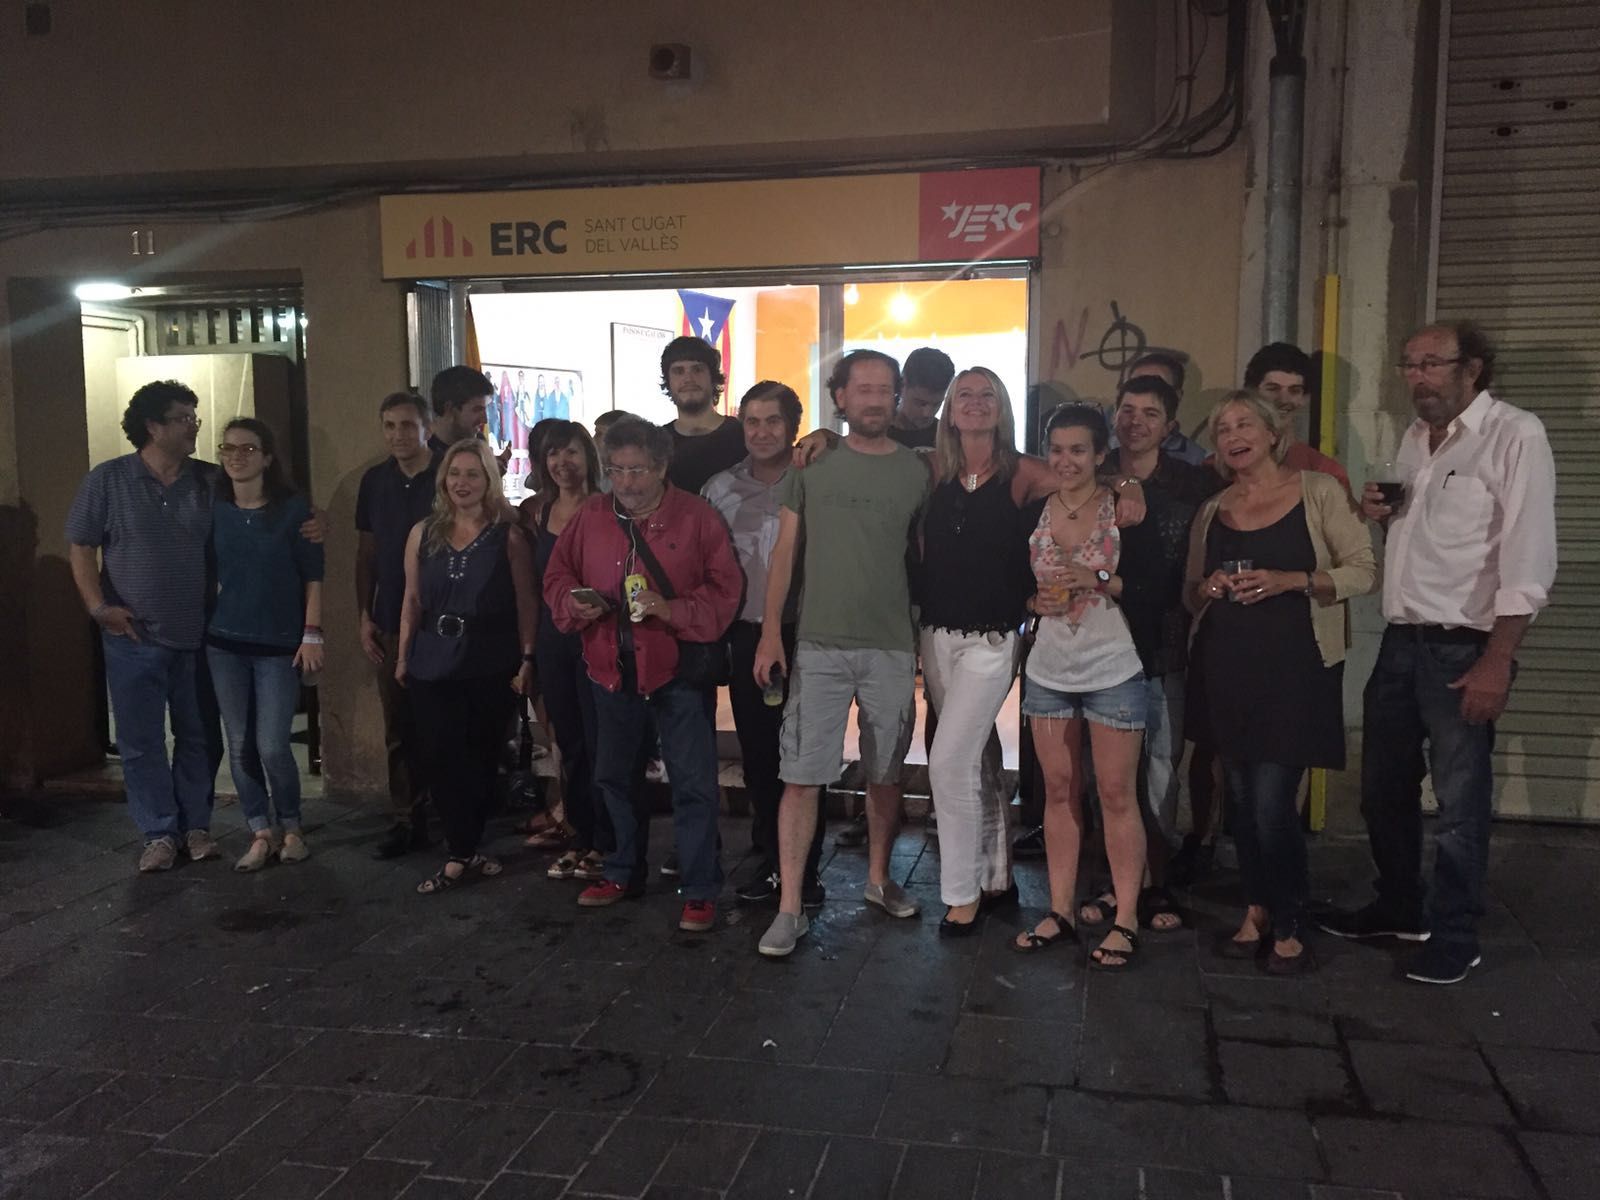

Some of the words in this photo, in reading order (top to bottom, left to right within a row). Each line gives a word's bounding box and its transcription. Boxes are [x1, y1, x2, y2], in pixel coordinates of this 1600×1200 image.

[583, 216, 627, 233] SANT
[631, 215, 687, 232] CUGAT
[948, 203, 1032, 242] JERC
[131, 230, 155, 254] 11
[490, 219, 567, 256] ERC
[585, 238, 615, 254] DEL
[619, 234, 679, 252] VALLÈS
